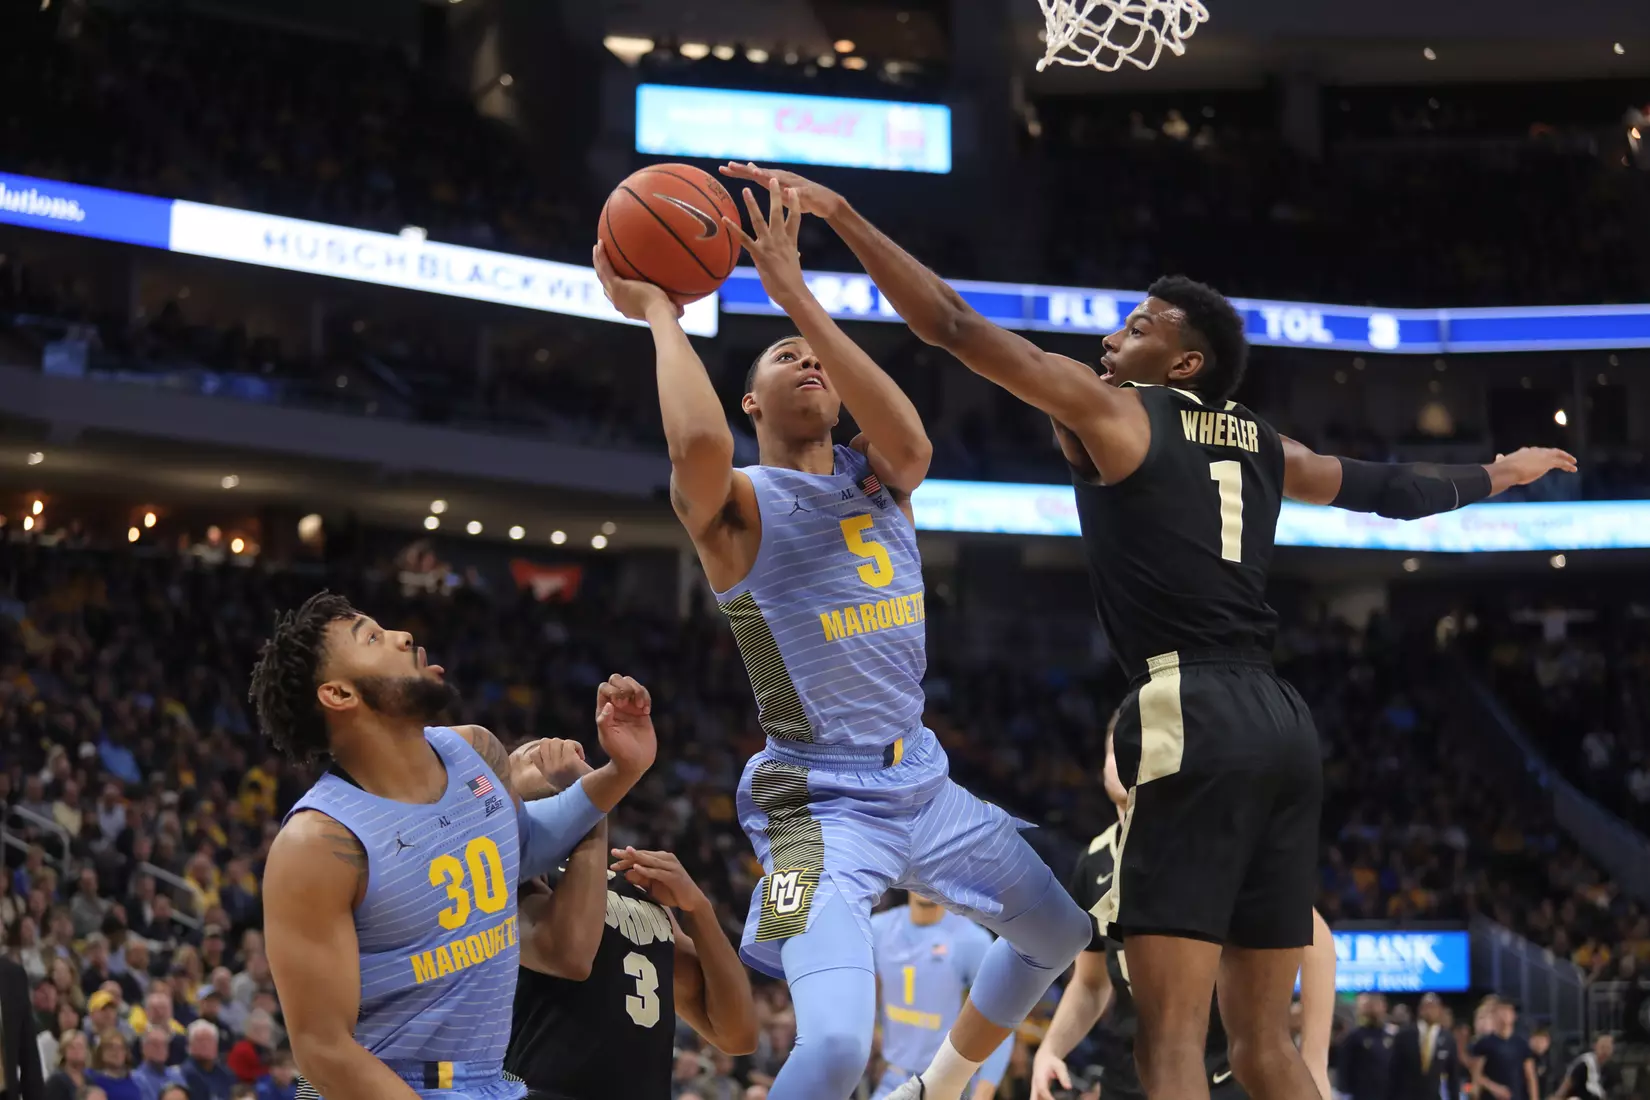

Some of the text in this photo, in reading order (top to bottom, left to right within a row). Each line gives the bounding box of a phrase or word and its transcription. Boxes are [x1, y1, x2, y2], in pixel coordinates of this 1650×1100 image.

[263, 229, 407, 269] HUSCH
[1048, 293, 1120, 330] FLS
[1261, 307, 1335, 344] TOL
[1180, 410, 1259, 453] WHEELER
[1209, 460, 1243, 563] 1
[840, 514, 894, 588] 5
[485, 795, 497, 807] BIG
[486, 799, 503, 813] EAST
[439, 816, 451, 828] AL
[428, 836, 508, 930] 30
[767, 868, 809, 916] MU
[1355, 933, 1444, 973] BANK
[623, 951, 660, 1028] 3
[903, 966, 916, 1005] 1
